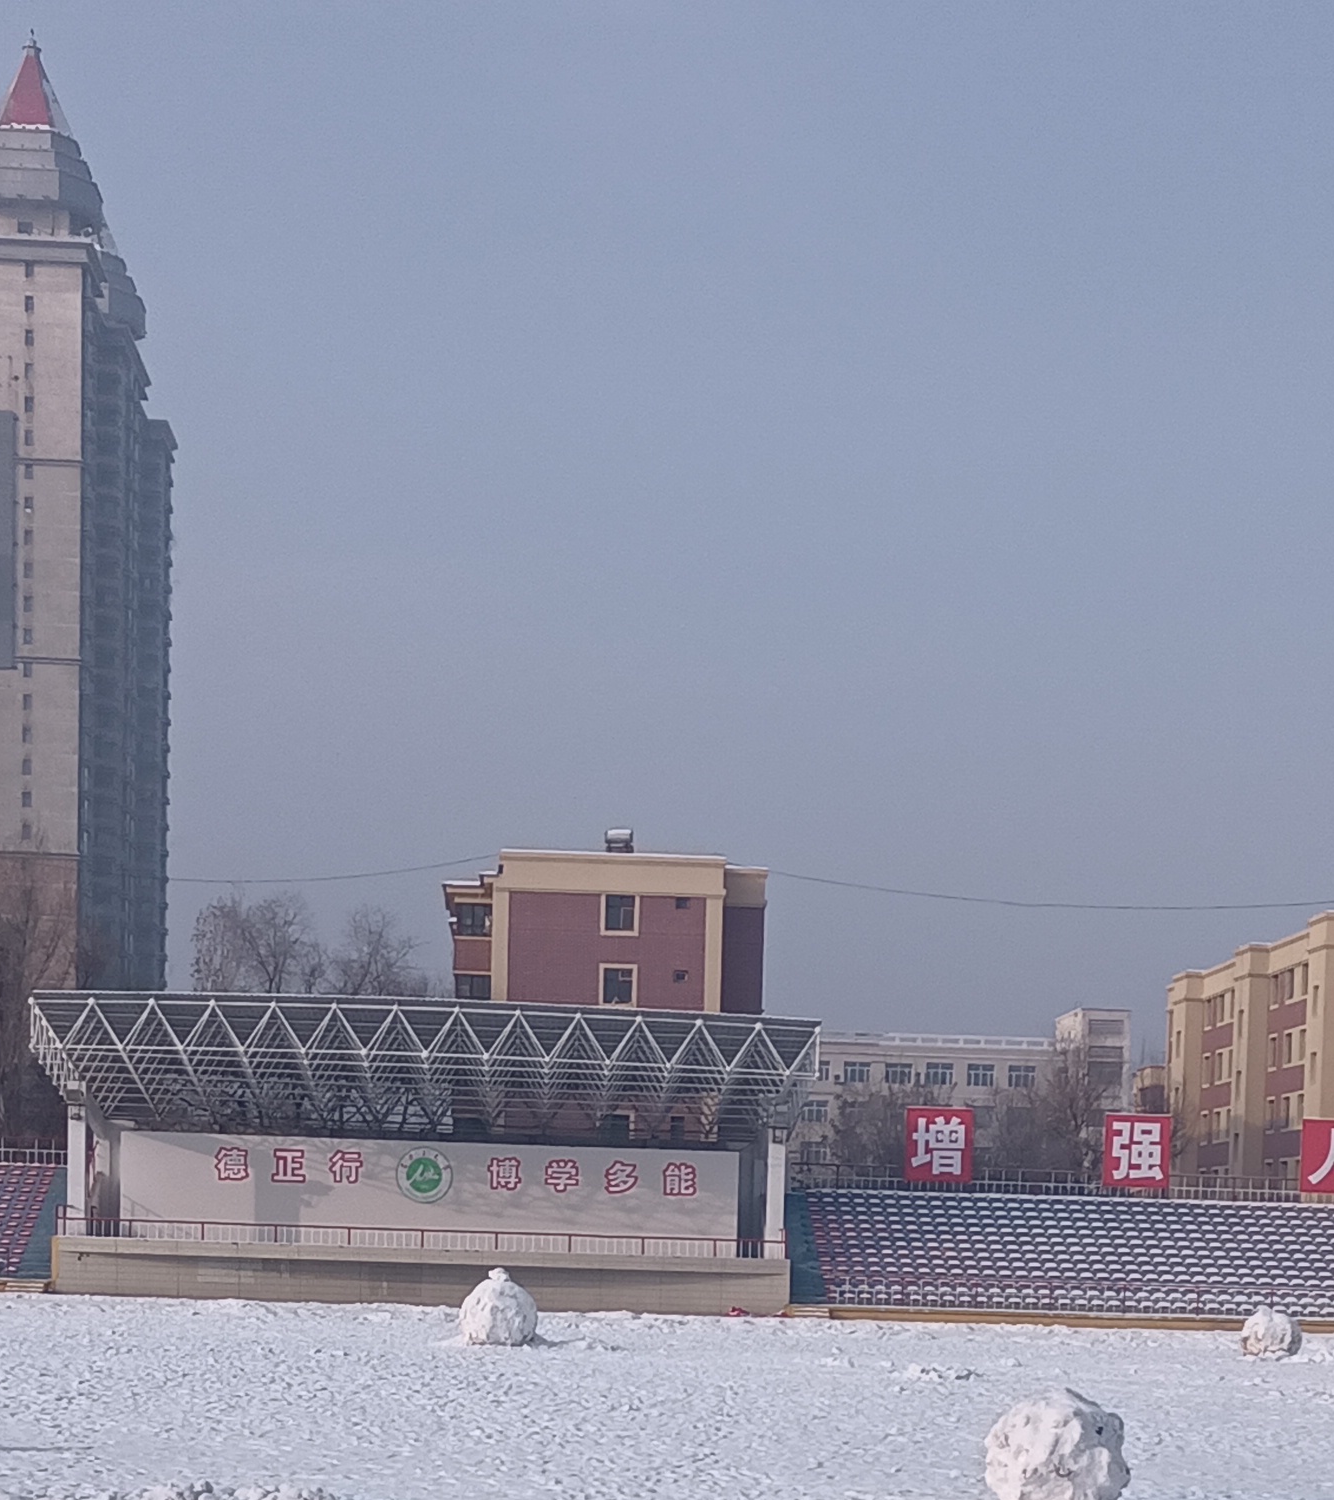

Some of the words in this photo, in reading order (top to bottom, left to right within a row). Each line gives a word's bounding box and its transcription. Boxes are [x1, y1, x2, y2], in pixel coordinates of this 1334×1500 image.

[214, 1146, 364, 1184] 德正行
[487, 1156, 697, 1197] 博学多能
[910, 1115, 966, 1177] 增
[1110, 1120, 1165, 1182] 强
